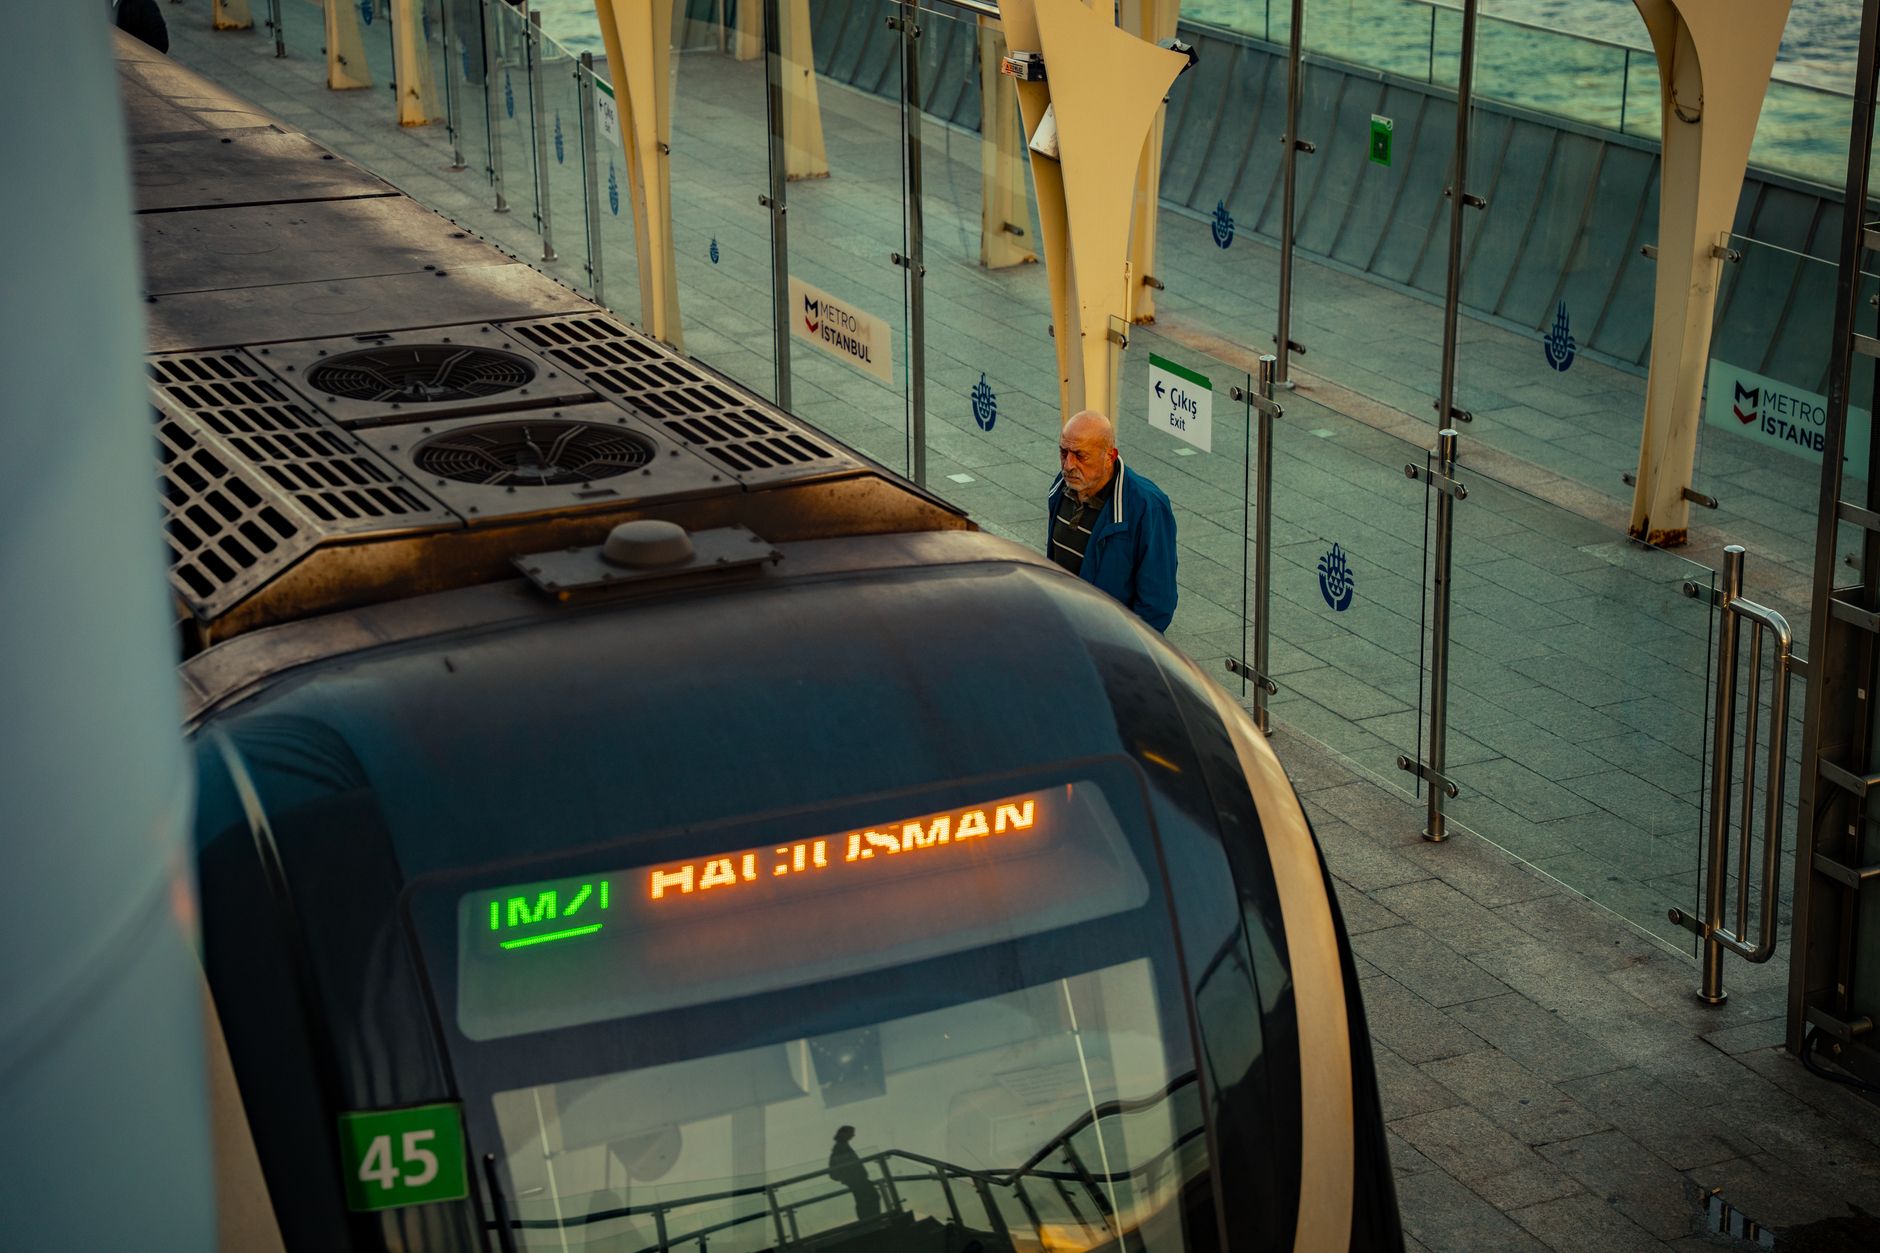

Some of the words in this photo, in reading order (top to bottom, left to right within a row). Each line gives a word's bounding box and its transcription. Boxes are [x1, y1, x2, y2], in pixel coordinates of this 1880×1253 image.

[820, 301, 857, 333] METRO
[820, 321, 872, 364] İSTANBUL
[1169, 412, 1186, 432] Exit
[1170, 387, 1198, 420] Çıkış
[1763, 389, 1826, 427] METRO
[1760, 410, 1849, 462] İSTANB
[358, 1129, 439, 1190] 45
